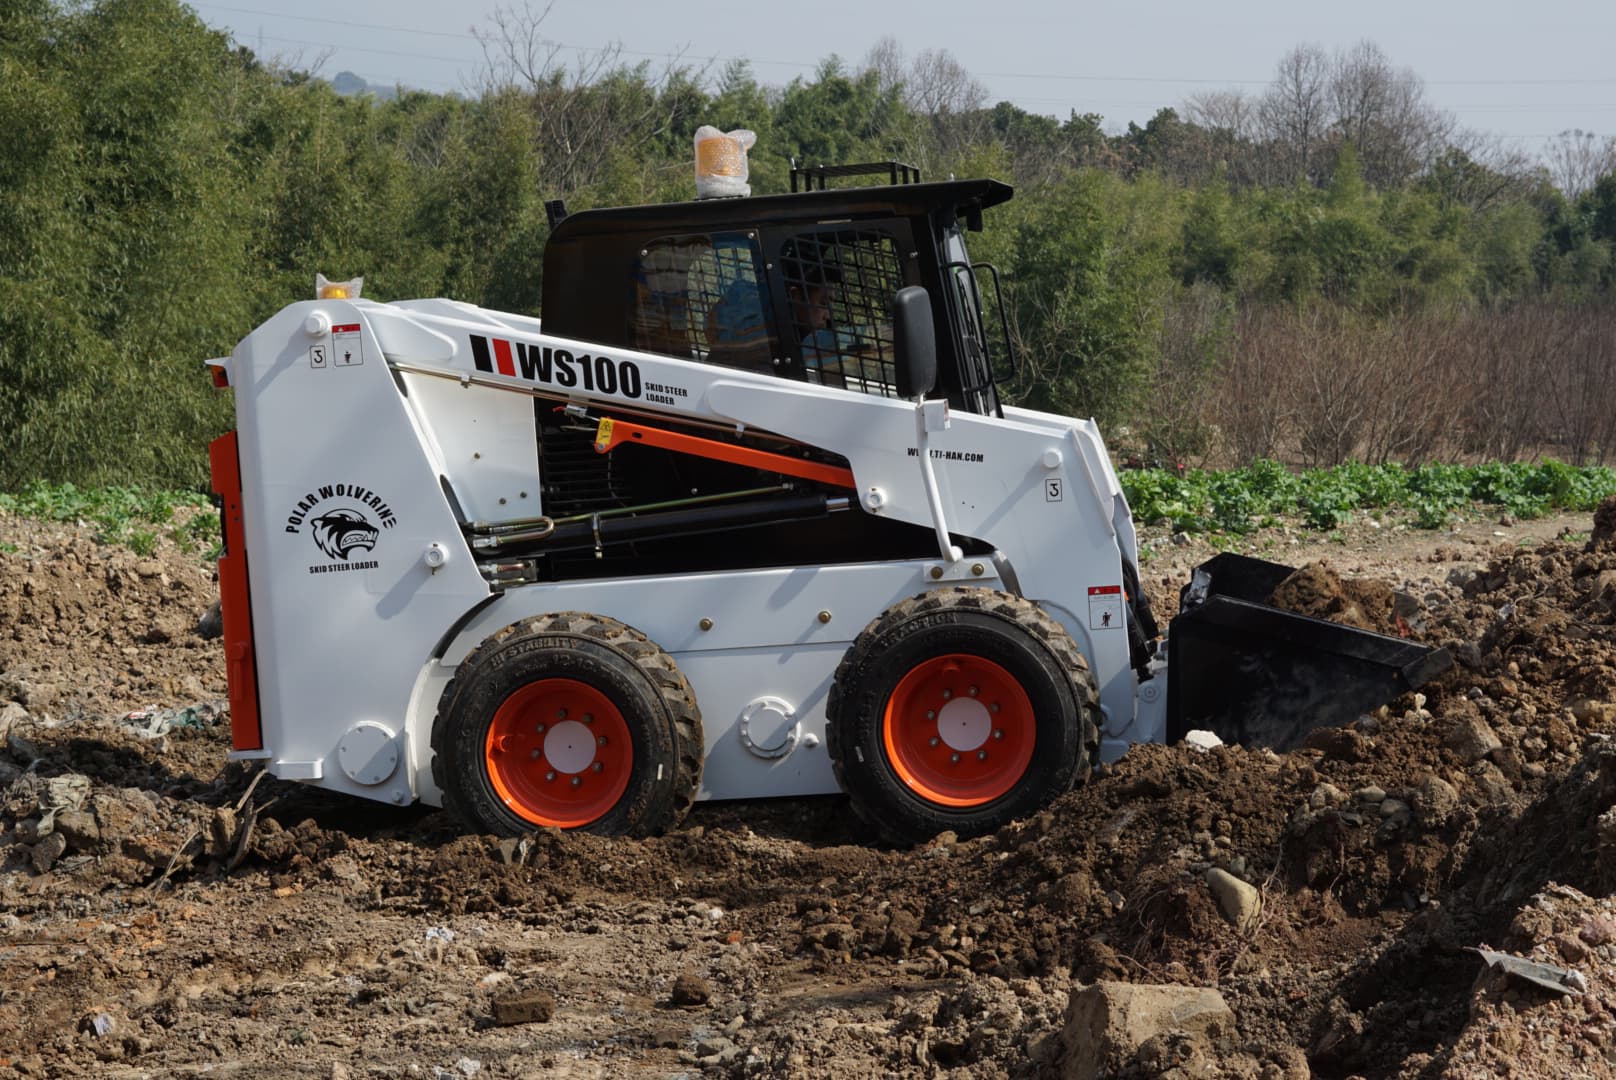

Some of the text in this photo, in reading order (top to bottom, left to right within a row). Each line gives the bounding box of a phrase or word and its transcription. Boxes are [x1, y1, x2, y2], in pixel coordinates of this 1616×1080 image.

[515, 342, 642, 398] WS100
[645, 381, 688, 397] SKID STEER
[646, 393, 675, 405] LOADER
[285, 483, 397, 534] POLAR WOLVERINE
[309, 560, 379, 575] SKID STEER LOADER
